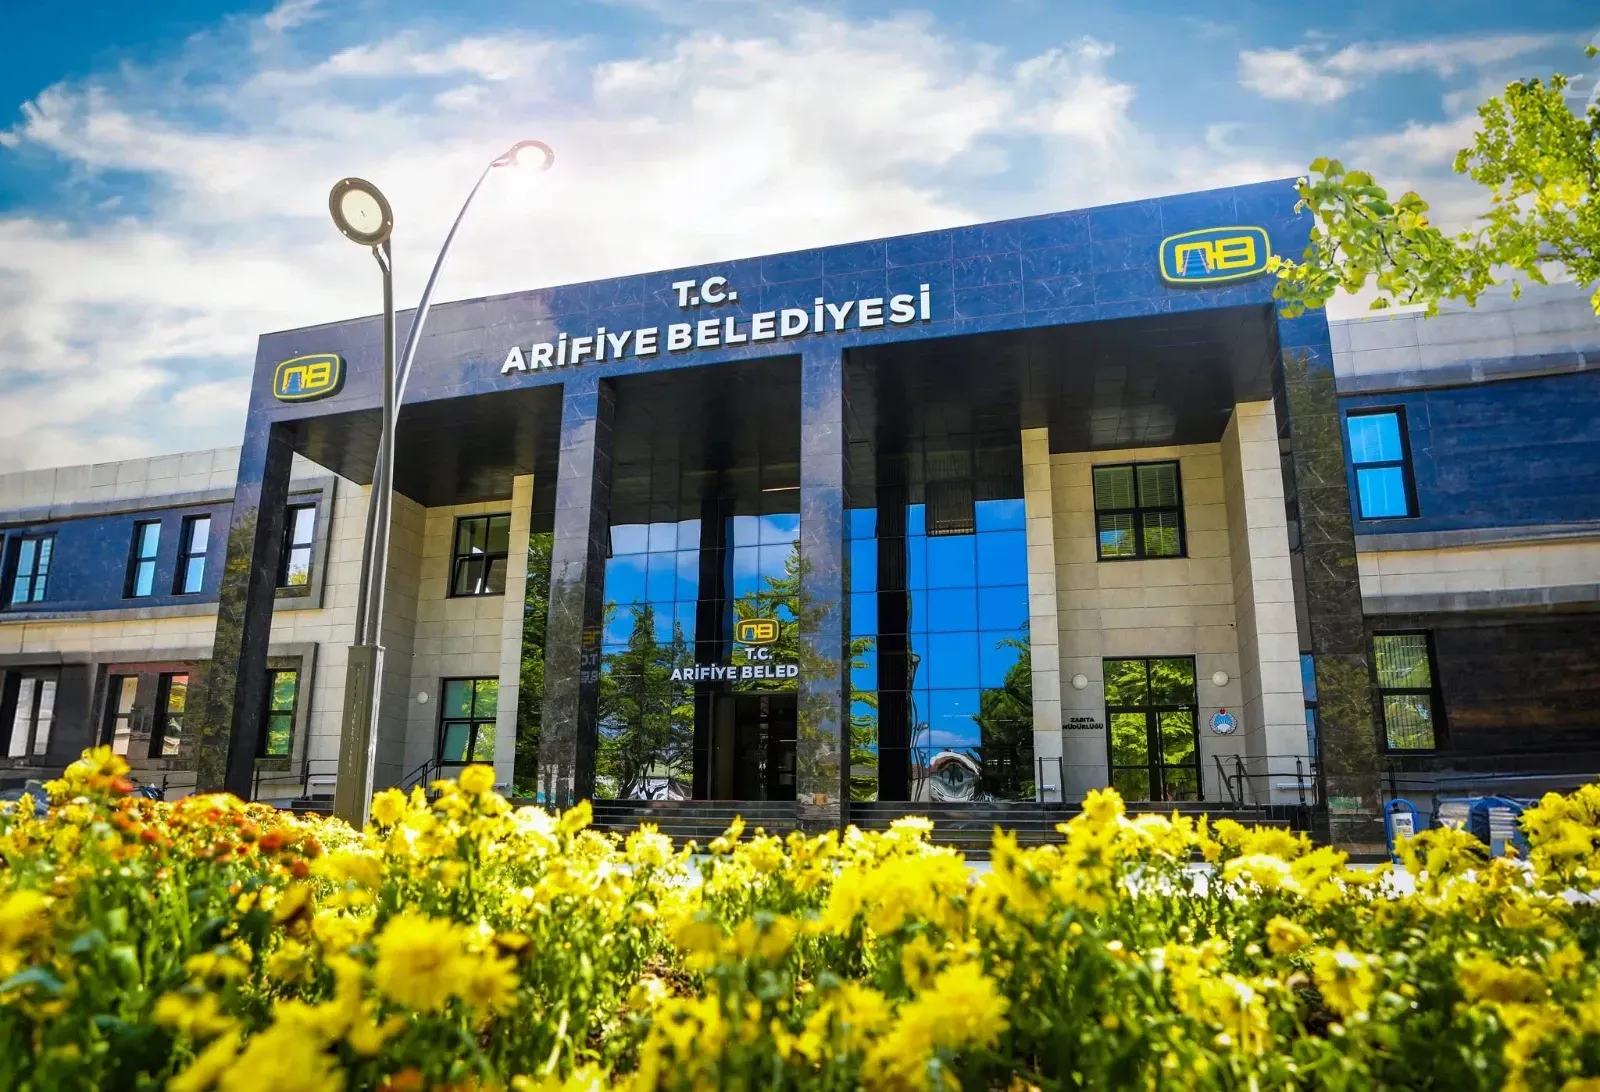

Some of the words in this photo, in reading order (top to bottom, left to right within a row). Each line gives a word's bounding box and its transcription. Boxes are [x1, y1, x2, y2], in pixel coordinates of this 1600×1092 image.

[672, 276, 738, 307] T.C.
[501, 326, 658, 374] ARİFİYE
[667, 283, 931, 352] BELEDİYESİ
[744, 647, 773, 660] T.C.
[670, 663, 737, 681] ARİFİYE
[742, 664, 799, 679] BELED
